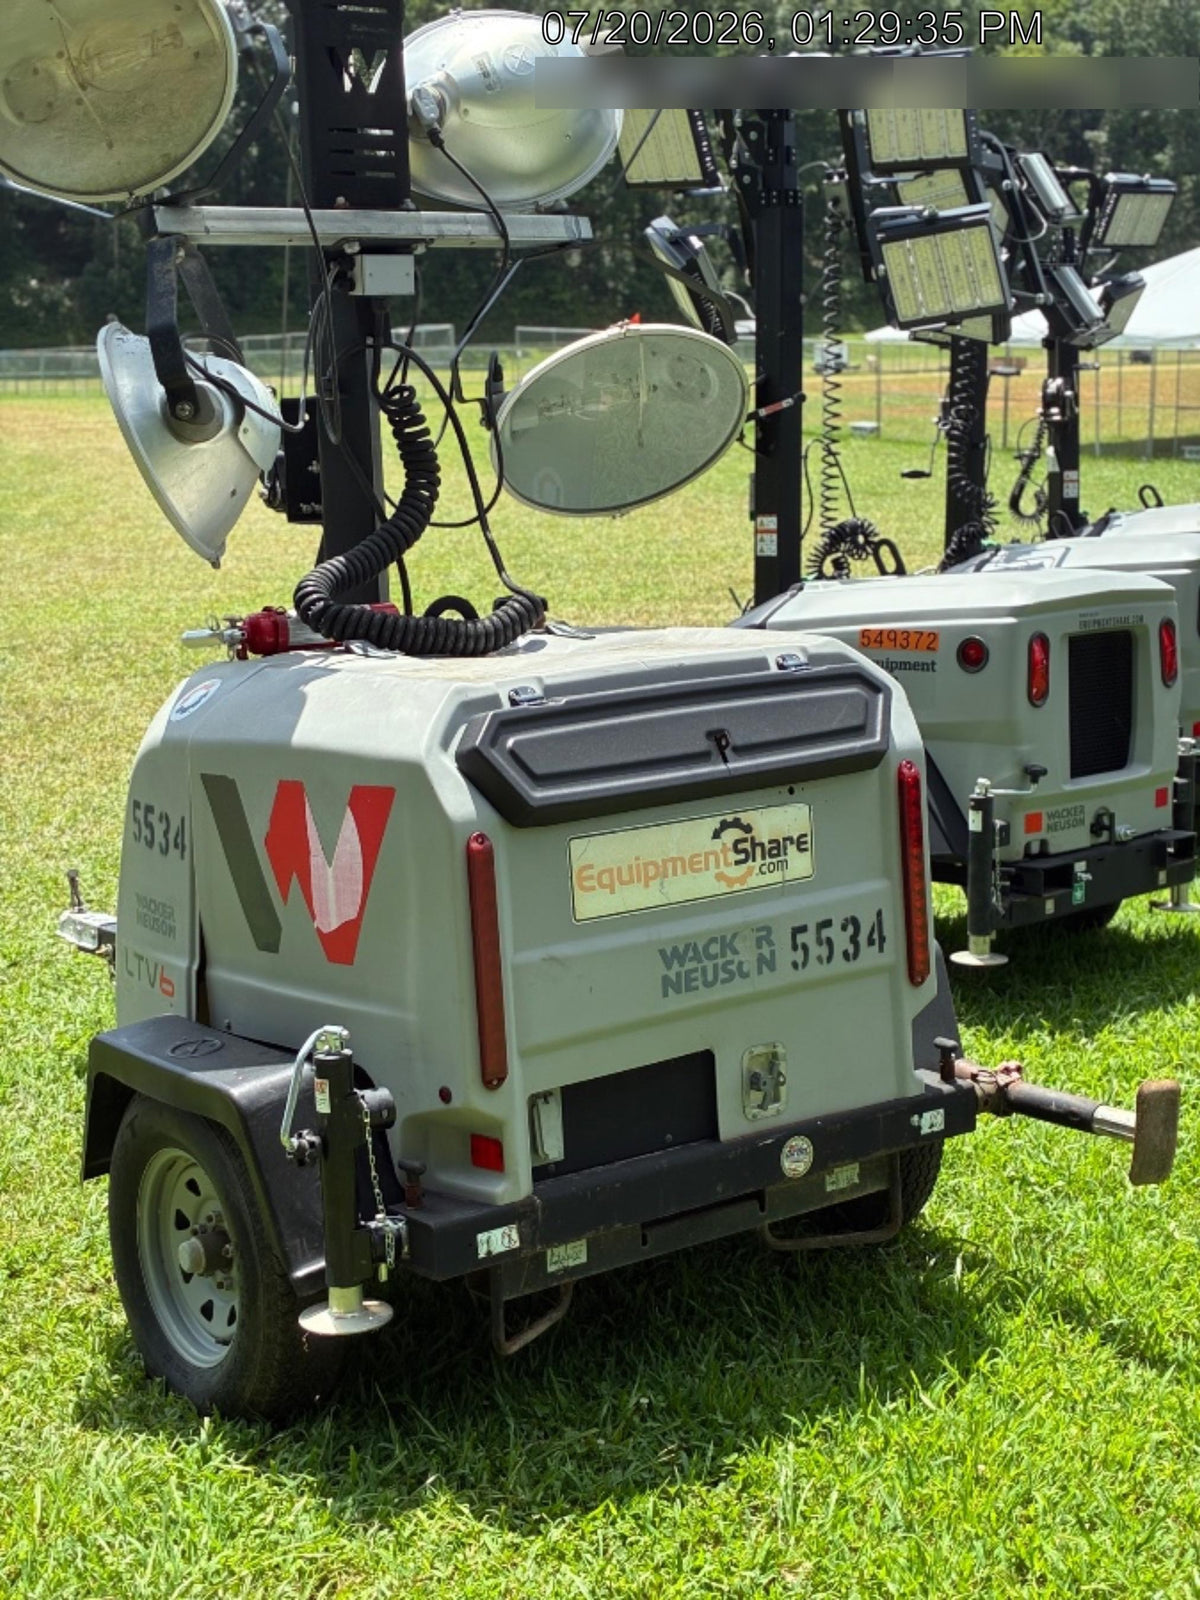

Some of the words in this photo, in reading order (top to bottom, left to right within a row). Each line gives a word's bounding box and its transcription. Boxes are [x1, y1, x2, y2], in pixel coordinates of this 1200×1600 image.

[860, 628, 938, 652] 549372
[873, 657, 937, 673] uipment
[1046, 804, 1086, 821] WACKER
[1046, 816, 1086, 833] NEUSON
[132, 799, 187, 861] 5534
[575, 833, 809, 895] EquipmentShare
[755, 859, 789, 877] .com
[658, 925, 776, 970] WACKR
[790, 908, 887, 972] 5534
